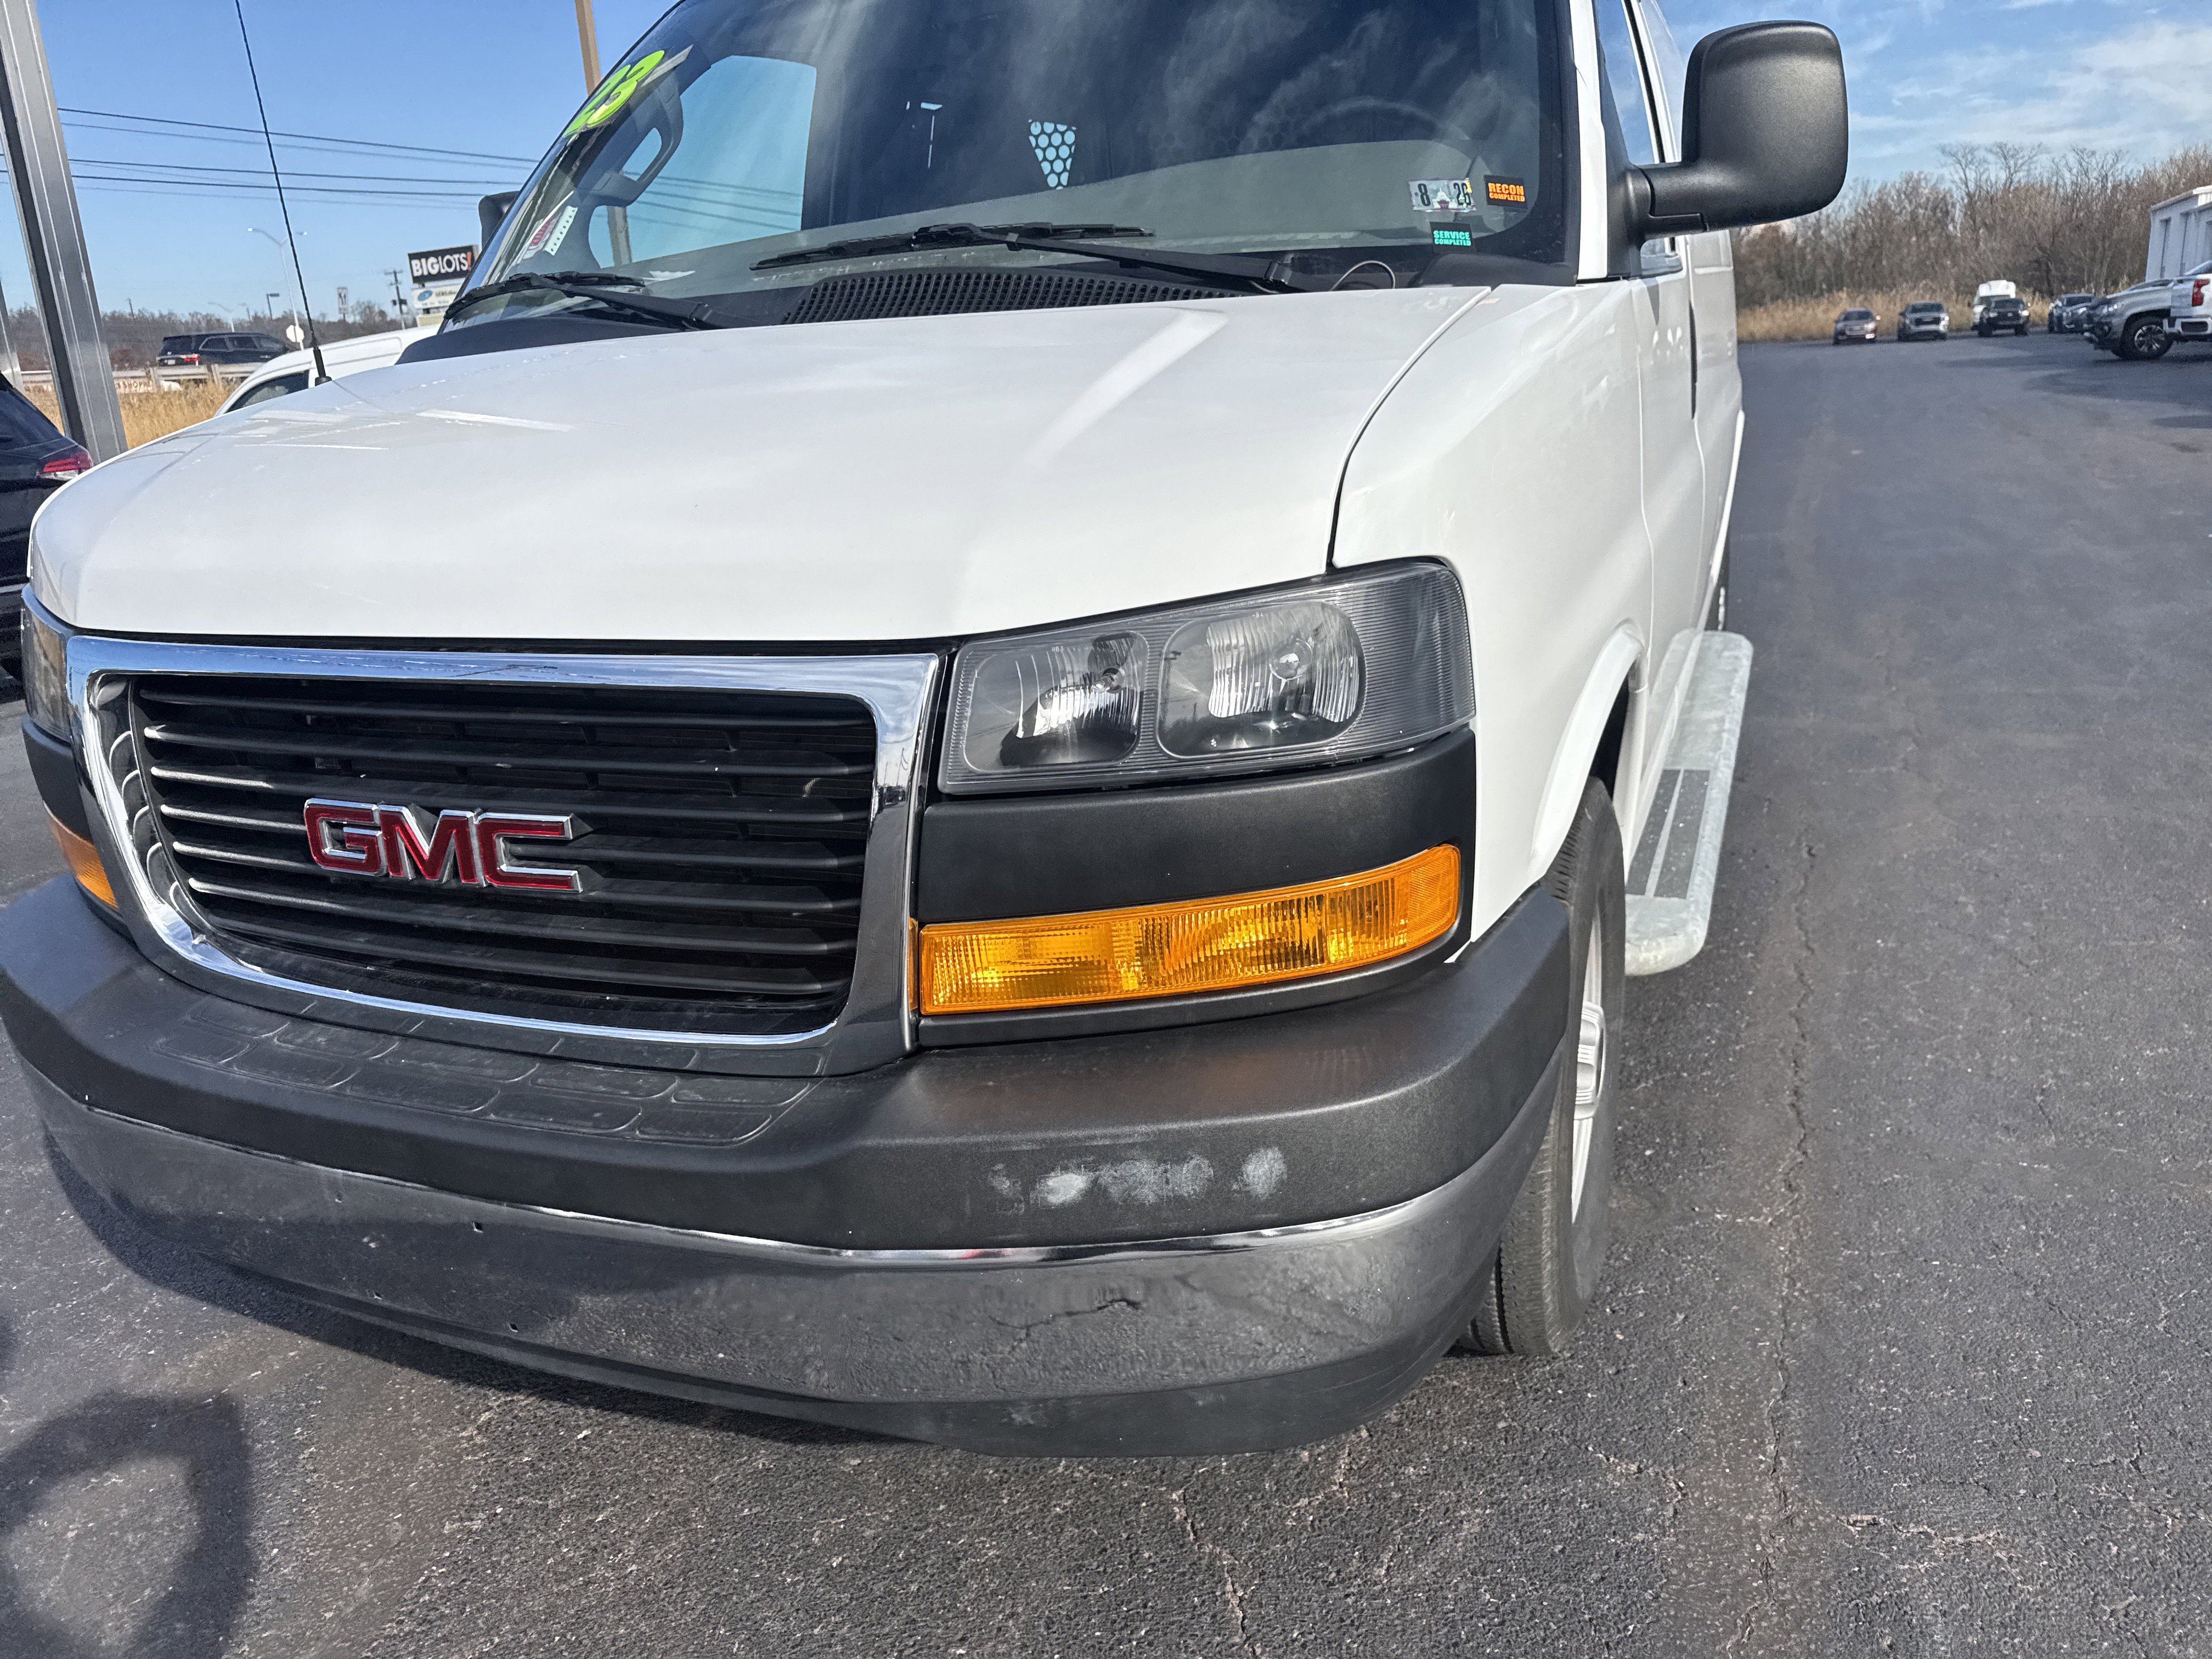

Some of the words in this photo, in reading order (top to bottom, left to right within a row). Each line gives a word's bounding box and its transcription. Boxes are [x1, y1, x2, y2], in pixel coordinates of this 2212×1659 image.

[1418, 183, 1431, 206] 8
[1488, 183, 1524, 195] RECON
[1489, 193, 1525, 202] COMPLETED
[1434, 230, 1470, 240] SERVICE
[1434, 238, 1471, 246] COMPLETED
[304, 798, 583, 893] GMC
